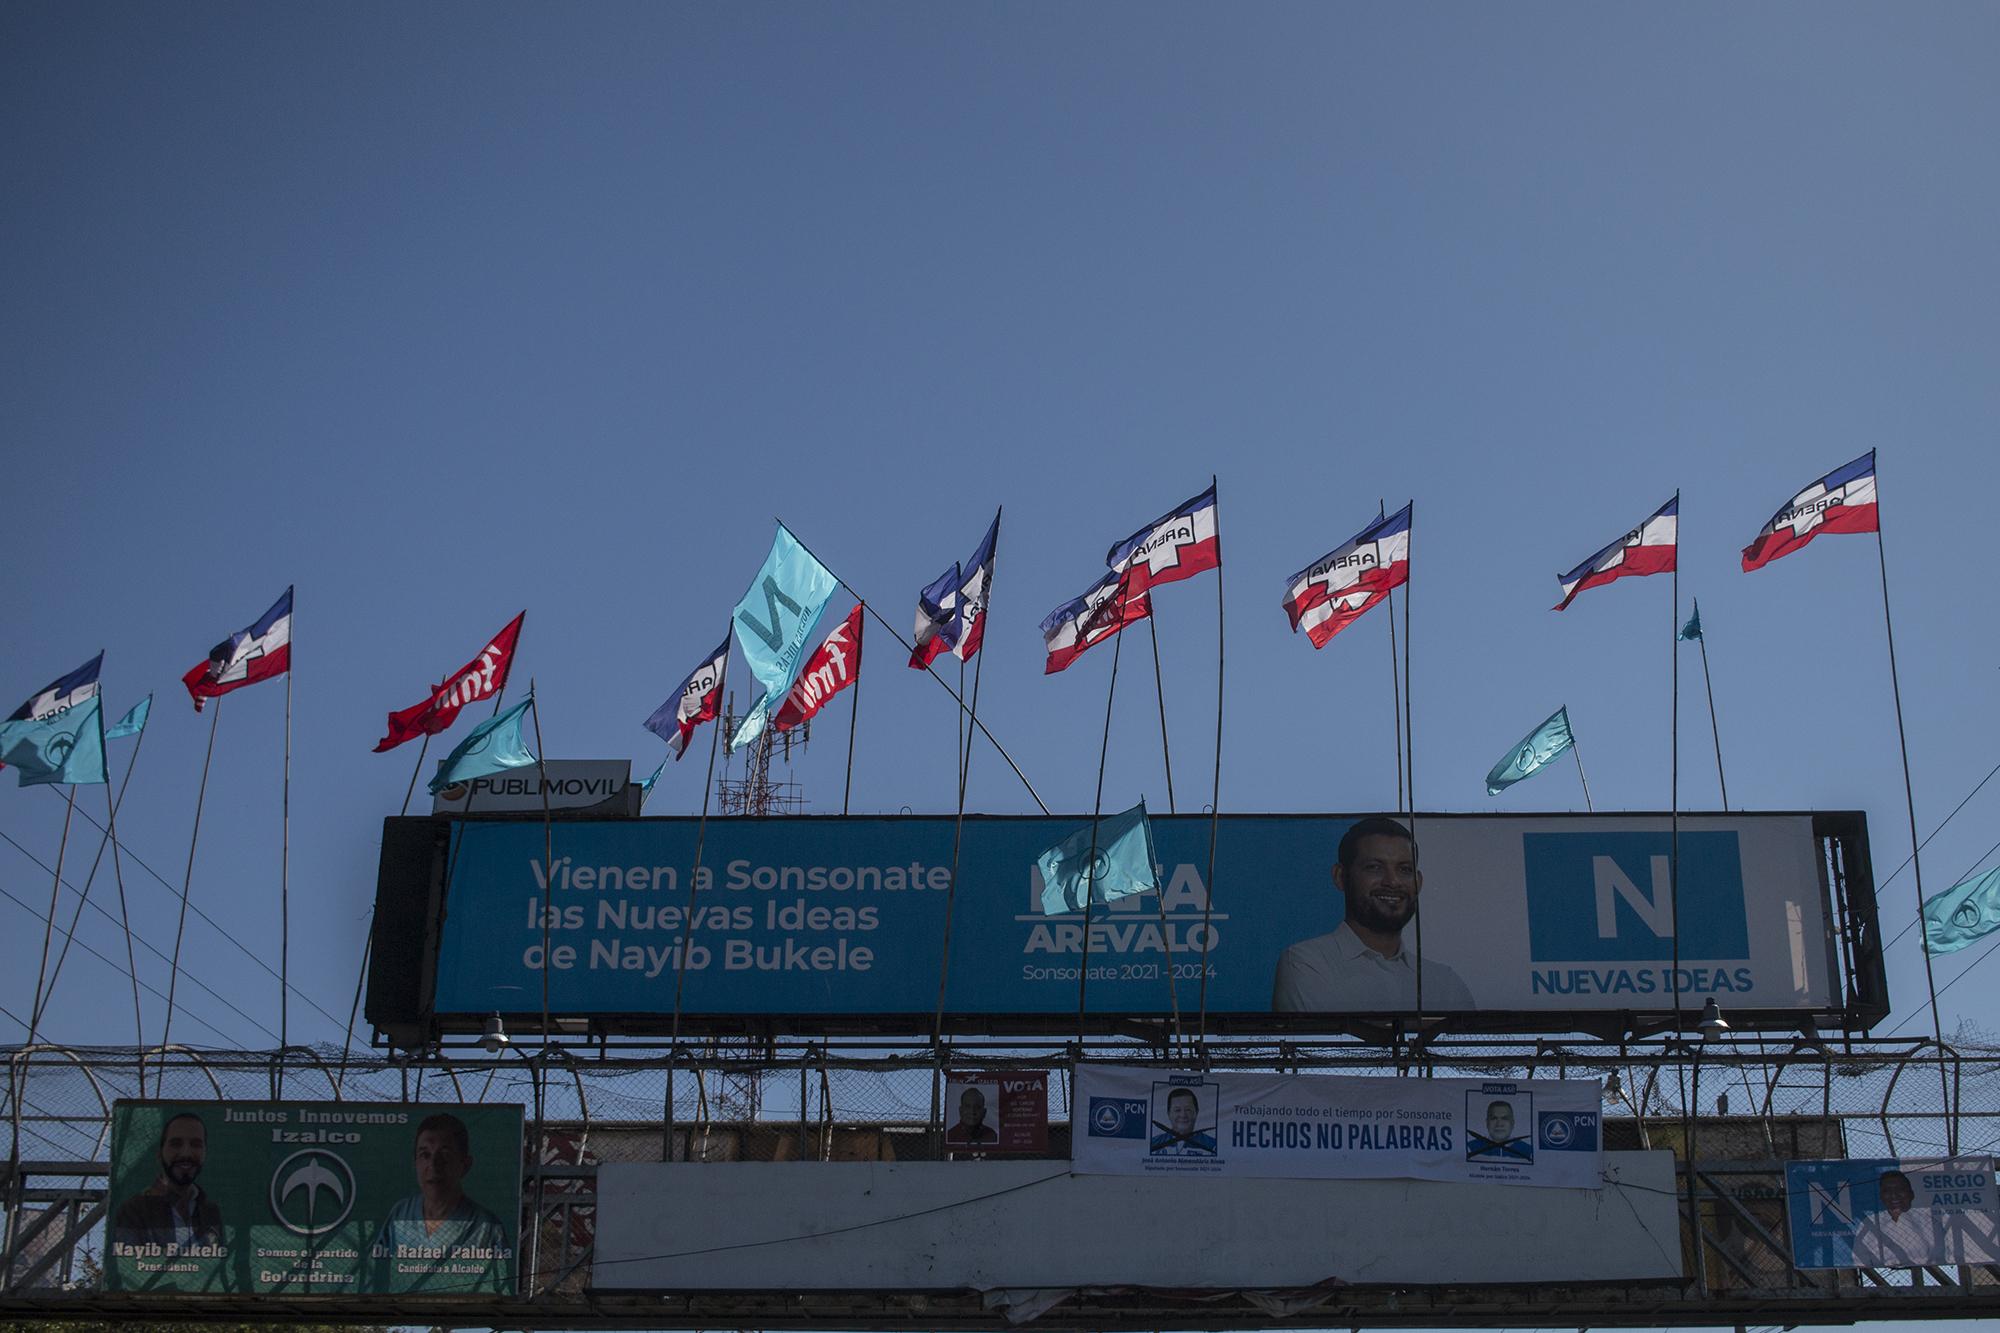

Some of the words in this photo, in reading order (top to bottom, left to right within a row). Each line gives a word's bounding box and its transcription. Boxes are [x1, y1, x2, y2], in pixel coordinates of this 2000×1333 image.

[474, 779, 621, 795] PUBLIMOVIL
[529, 857, 678, 890] Vienen
[691, 865, 713, 890] a
[726, 860, 952, 891] Sonsonate
[1593, 855, 1675, 938] N
[527, 897, 585, 929] las
[597, 899, 754, 930] Nuevas
[767, 898, 880, 930] Ideas
[1023, 916, 1220, 953] ARÉVALO
[523, 937, 577, 970] de
[590, 936, 712, 977] Nayib
[725, 938, 875, 971] Bukele
[1023, 964, 1119, 980] Sonsonate
[1120, 964, 1159, 980] 2021
[1172, 964, 1217, 980] 2024
[1531, 969, 1656, 994] NUEVAS
[1662, 968, 1754, 993] IDEAS
[1003, 1080, 1044, 1094] VOTA
[223, 1108, 289, 1123] Juntos
[299, 1109, 409, 1125] Innovemos
[1124, 1103, 1146, 1115] PCN
[1233, 1104, 1293, 1117] Trabajando
[1295, 1106, 1319, 1117] todo
[1322, 1106, 1332, 1117] el
[1335, 1107, 1372, 1120] tiempo
[1375, 1109, 1394, 1121] por
[1397, 1108, 1453, 1120] Sonsonate
[1573, 1115, 1596, 1127] PCN
[271, 1129, 361, 1145] Izalco
[1232, 1120, 1312, 1149] HECHOS
[1316, 1122, 1343, 1150] NO
[1348, 1123, 1453, 1151] PALABRAS
[1923, 1174, 1986, 1189] SERGIO
[1808, 1181, 1853, 1225] N
[1931, 1192, 1982, 1206] ARIAS
[111, 1242, 162, 1260] Nayib
[166, 1242, 229, 1259] Bukele
[257, 1248, 298, 1259] Somos
[300, 1247, 313, 1258] el
[315, 1248, 360, 1262] partido
[372, 1244, 393, 1260] Dr.
[397, 1244, 447, 1260] Rafael
[450, 1245, 513, 1261] Palucha
[137, 1262, 200, 1273] Presidente
[311, 1259, 323, 1269] la
[260, 1271, 354, 1284] Golondrina
